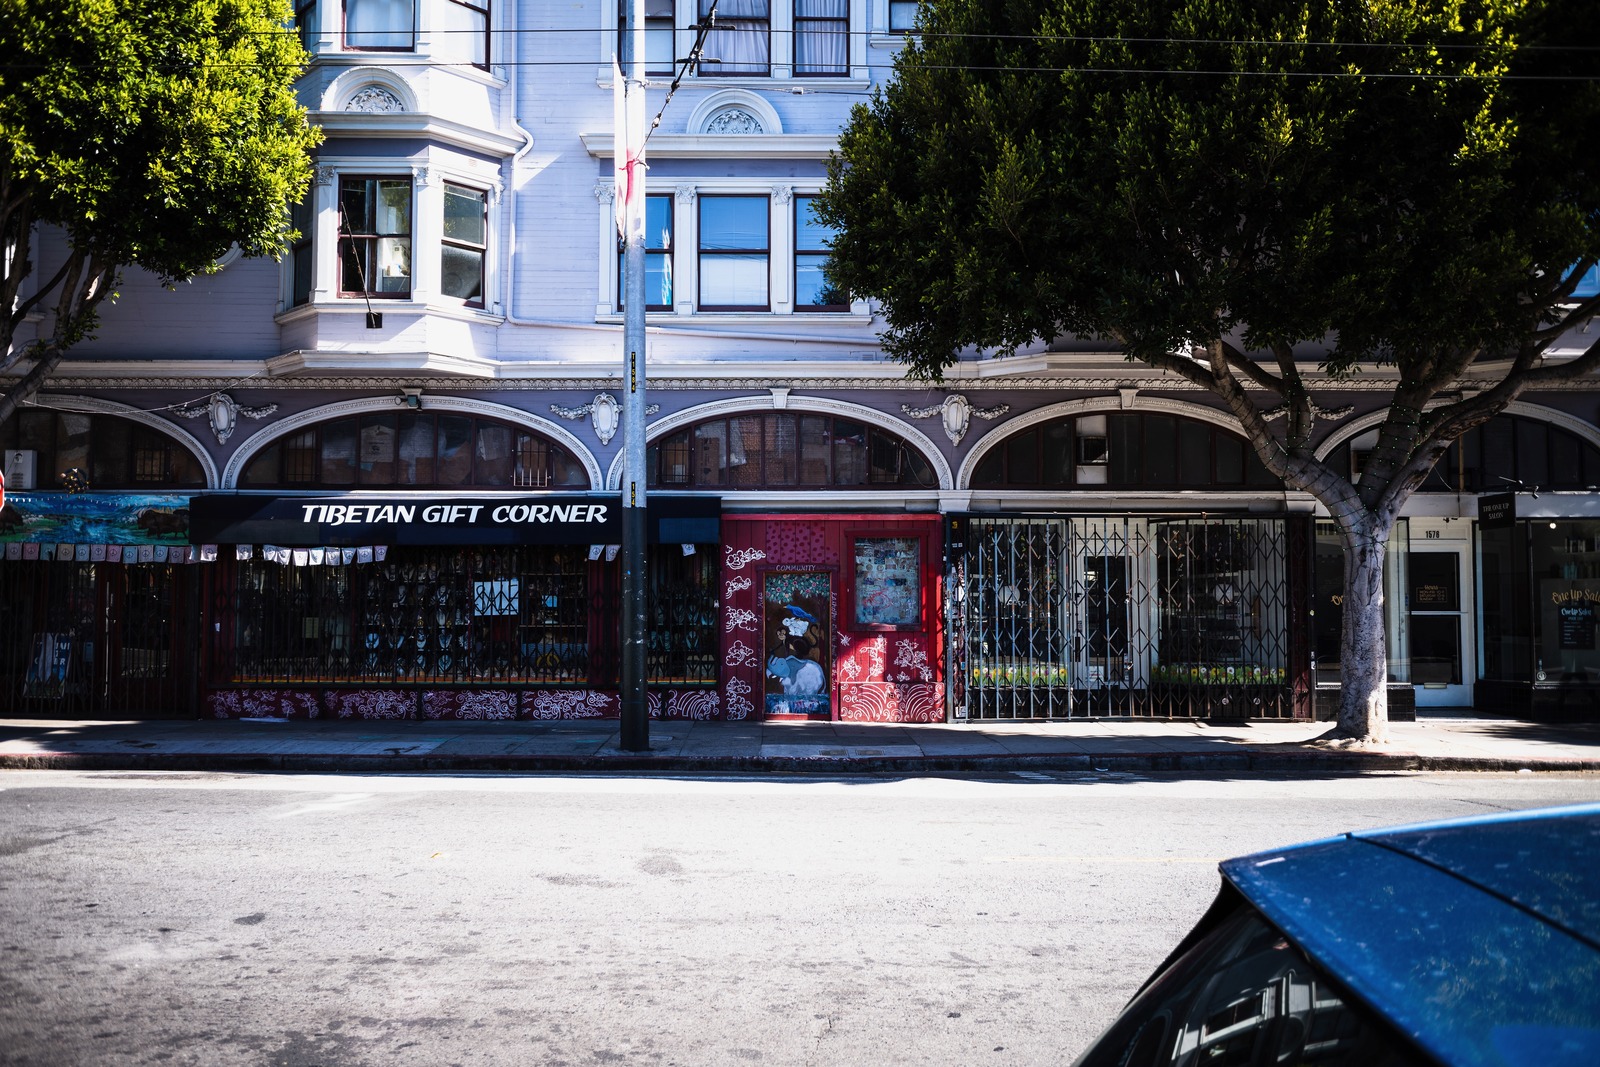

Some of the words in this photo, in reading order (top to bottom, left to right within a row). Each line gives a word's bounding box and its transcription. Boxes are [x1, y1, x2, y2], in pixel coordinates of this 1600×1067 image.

[302, 505, 416, 526] TIBETAN
[422, 505, 484, 523] GIFT
[492, 505, 607, 523] CORNER
[1488, 511, 1504, 520] SALON
[1425, 530, 1440, 539] 1578
[1552, 591, 1569, 604] One
[1570, 588, 1583, 601] Up
